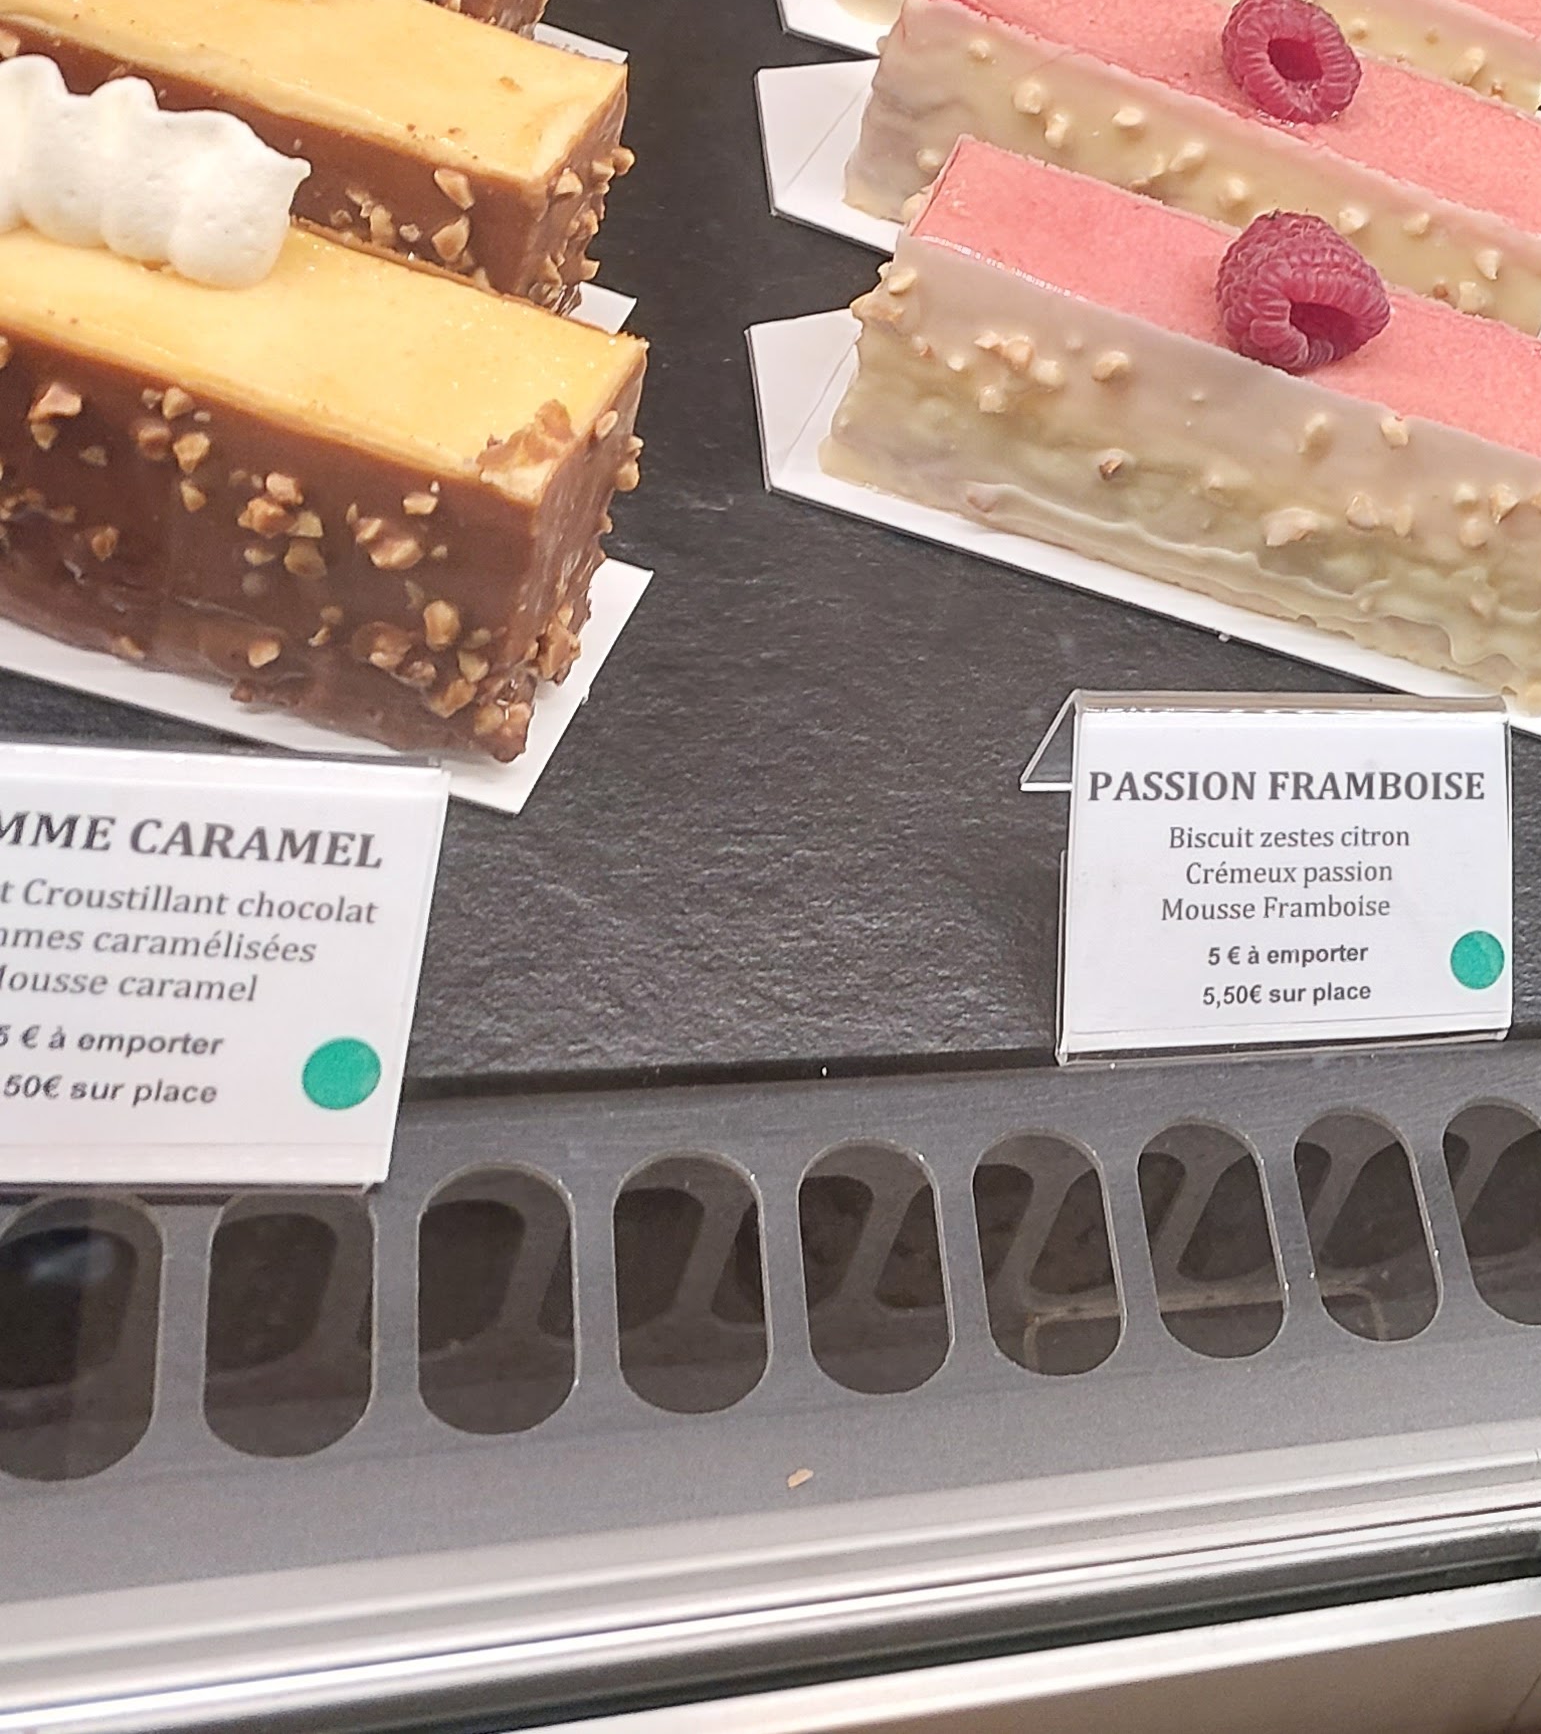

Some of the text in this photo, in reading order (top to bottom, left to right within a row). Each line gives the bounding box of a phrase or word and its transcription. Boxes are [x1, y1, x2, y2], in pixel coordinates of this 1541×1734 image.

[1087, 770, 1486, 802] PASSION FRAMBOISE
[129, 817, 384, 869] CARAMEL
[1168, 826, 1410, 849] Biscuit zestes citron
[1185, 862, 1393, 889] Crémeux passion
[22, 878, 229, 916] Croustillant
[237, 890, 379, 924] chocolat
[1161, 894, 1391, 922] Mousse Framboise
[0, 927, 318, 964] mes caramélisées
[1207, 944, 1369, 968] 5 € à emporter
[0, 964, 258, 1003] ousse caramel
[1202, 982, 1372, 1010] 5,50€ sur place
[22, 1024, 40, 1049] €
[48, 1026, 66, 1049] à
[77, 1033, 224, 1059] emporter
[70, 1080, 124, 1101] sur
[132, 1078, 217, 1108] place
